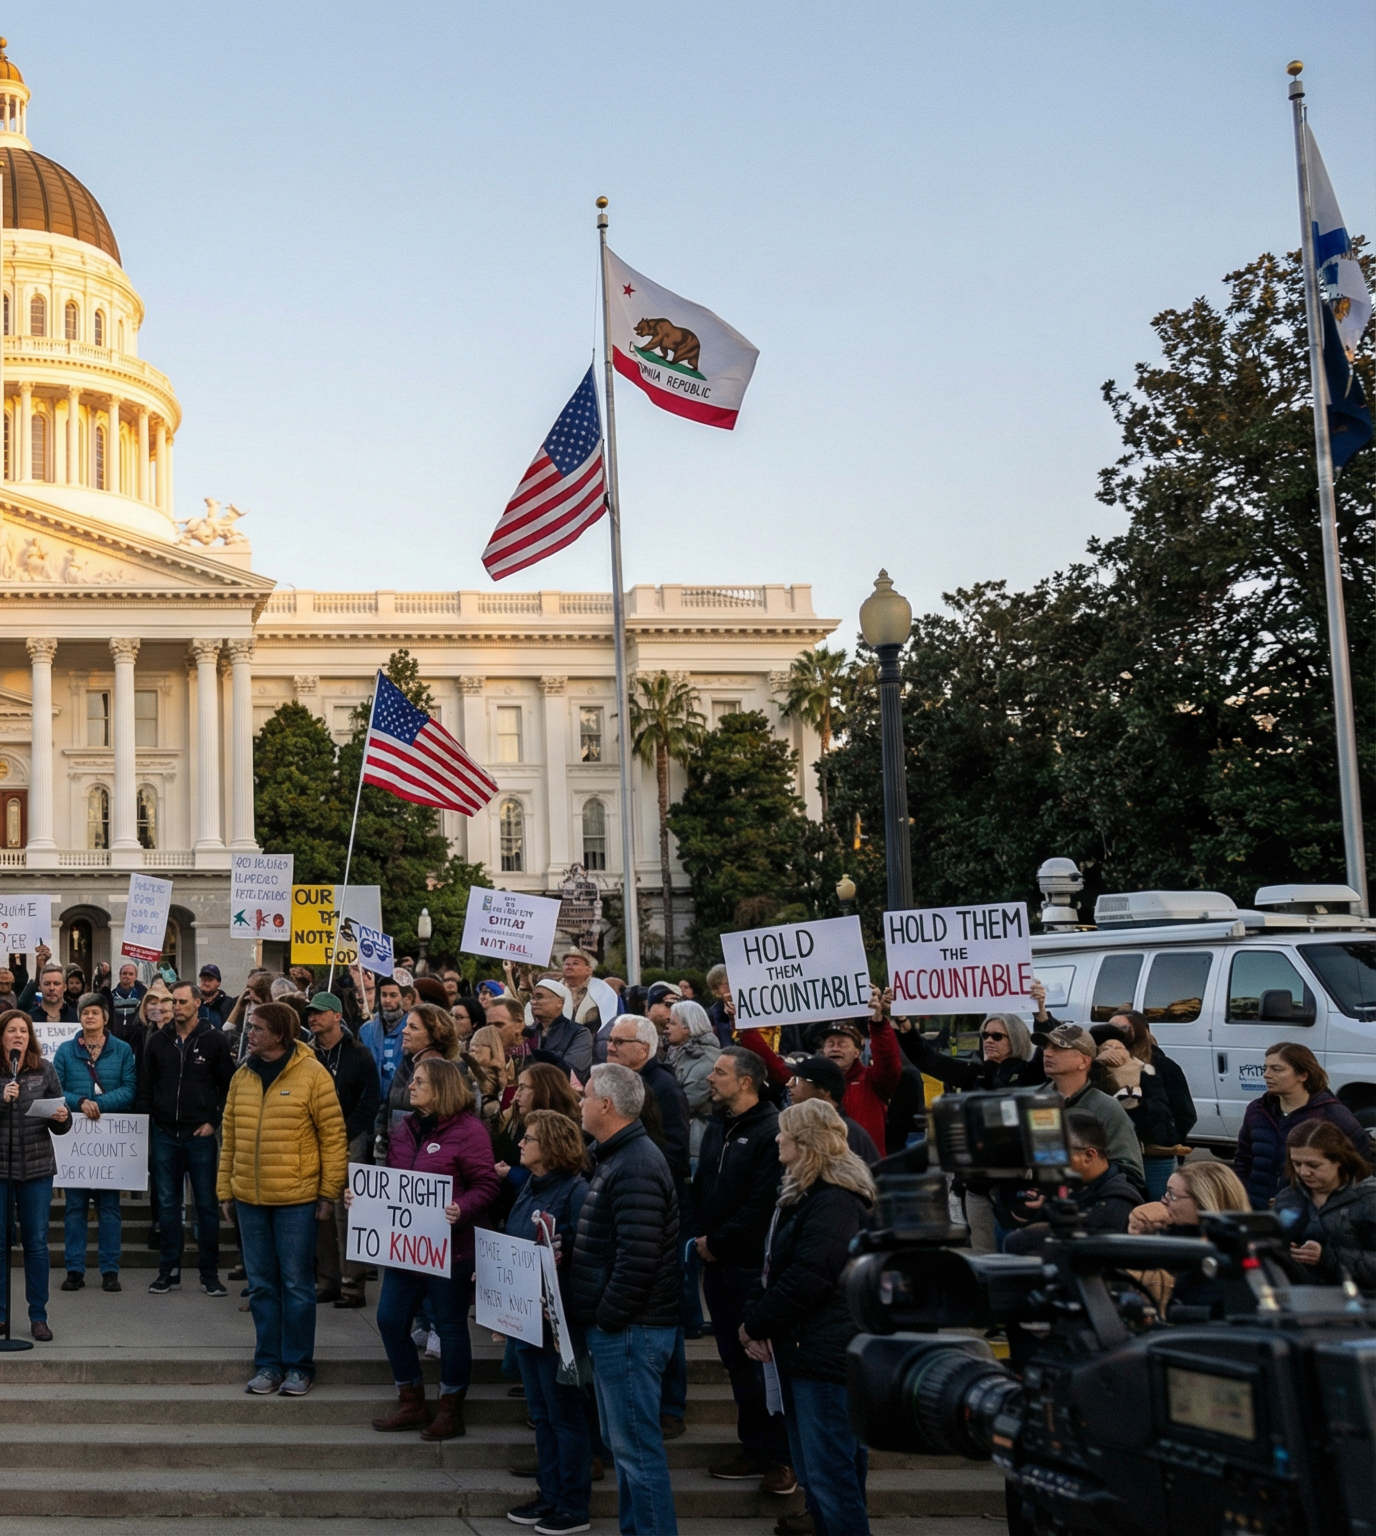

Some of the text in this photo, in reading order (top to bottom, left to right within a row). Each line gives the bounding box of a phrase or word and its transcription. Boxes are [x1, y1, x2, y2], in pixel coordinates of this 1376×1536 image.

[666, 375, 712, 399] REPUBLIC
[294, 888, 333, 906] OUR
[889, 907, 1023, 944] HOLD THEM
[743, 929, 814, 965] HOLD
[939, 947, 968, 961] THE
[765, 963, 804, 981] THEM
[892, 962, 1031, 1001] ACCOUNTABLE
[737, 972, 868, 1019] ACCOUNTABLE
[353, 1169, 450, 1209] OUR RIGHT
[387, 1205, 412, 1228] TO
[352, 1226, 380, 1257] TO
[389, 1231, 448, 1270] KNOW
